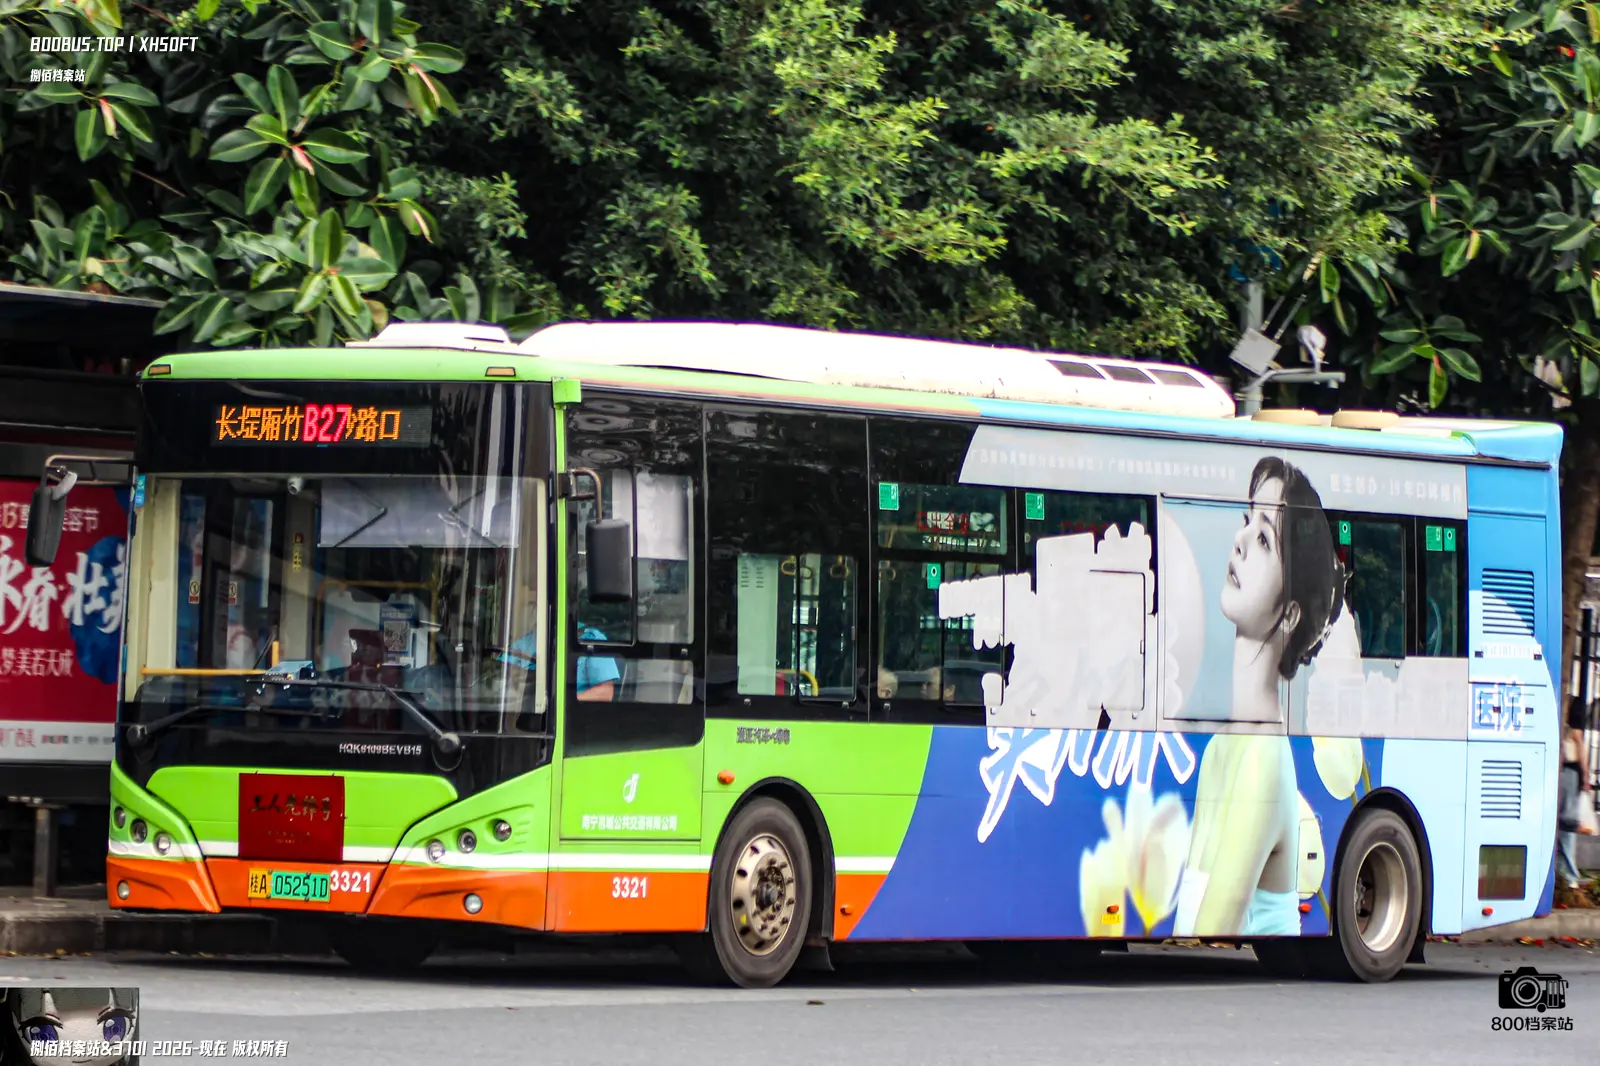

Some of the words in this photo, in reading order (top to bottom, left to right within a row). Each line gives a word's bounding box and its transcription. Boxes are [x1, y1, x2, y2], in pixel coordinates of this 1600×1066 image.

[302, 403, 351, 442] B27
[1472, 680, 1523, 732] 医院
[330, 870, 371, 893] 3321
[611, 876, 648, 899] 3321
